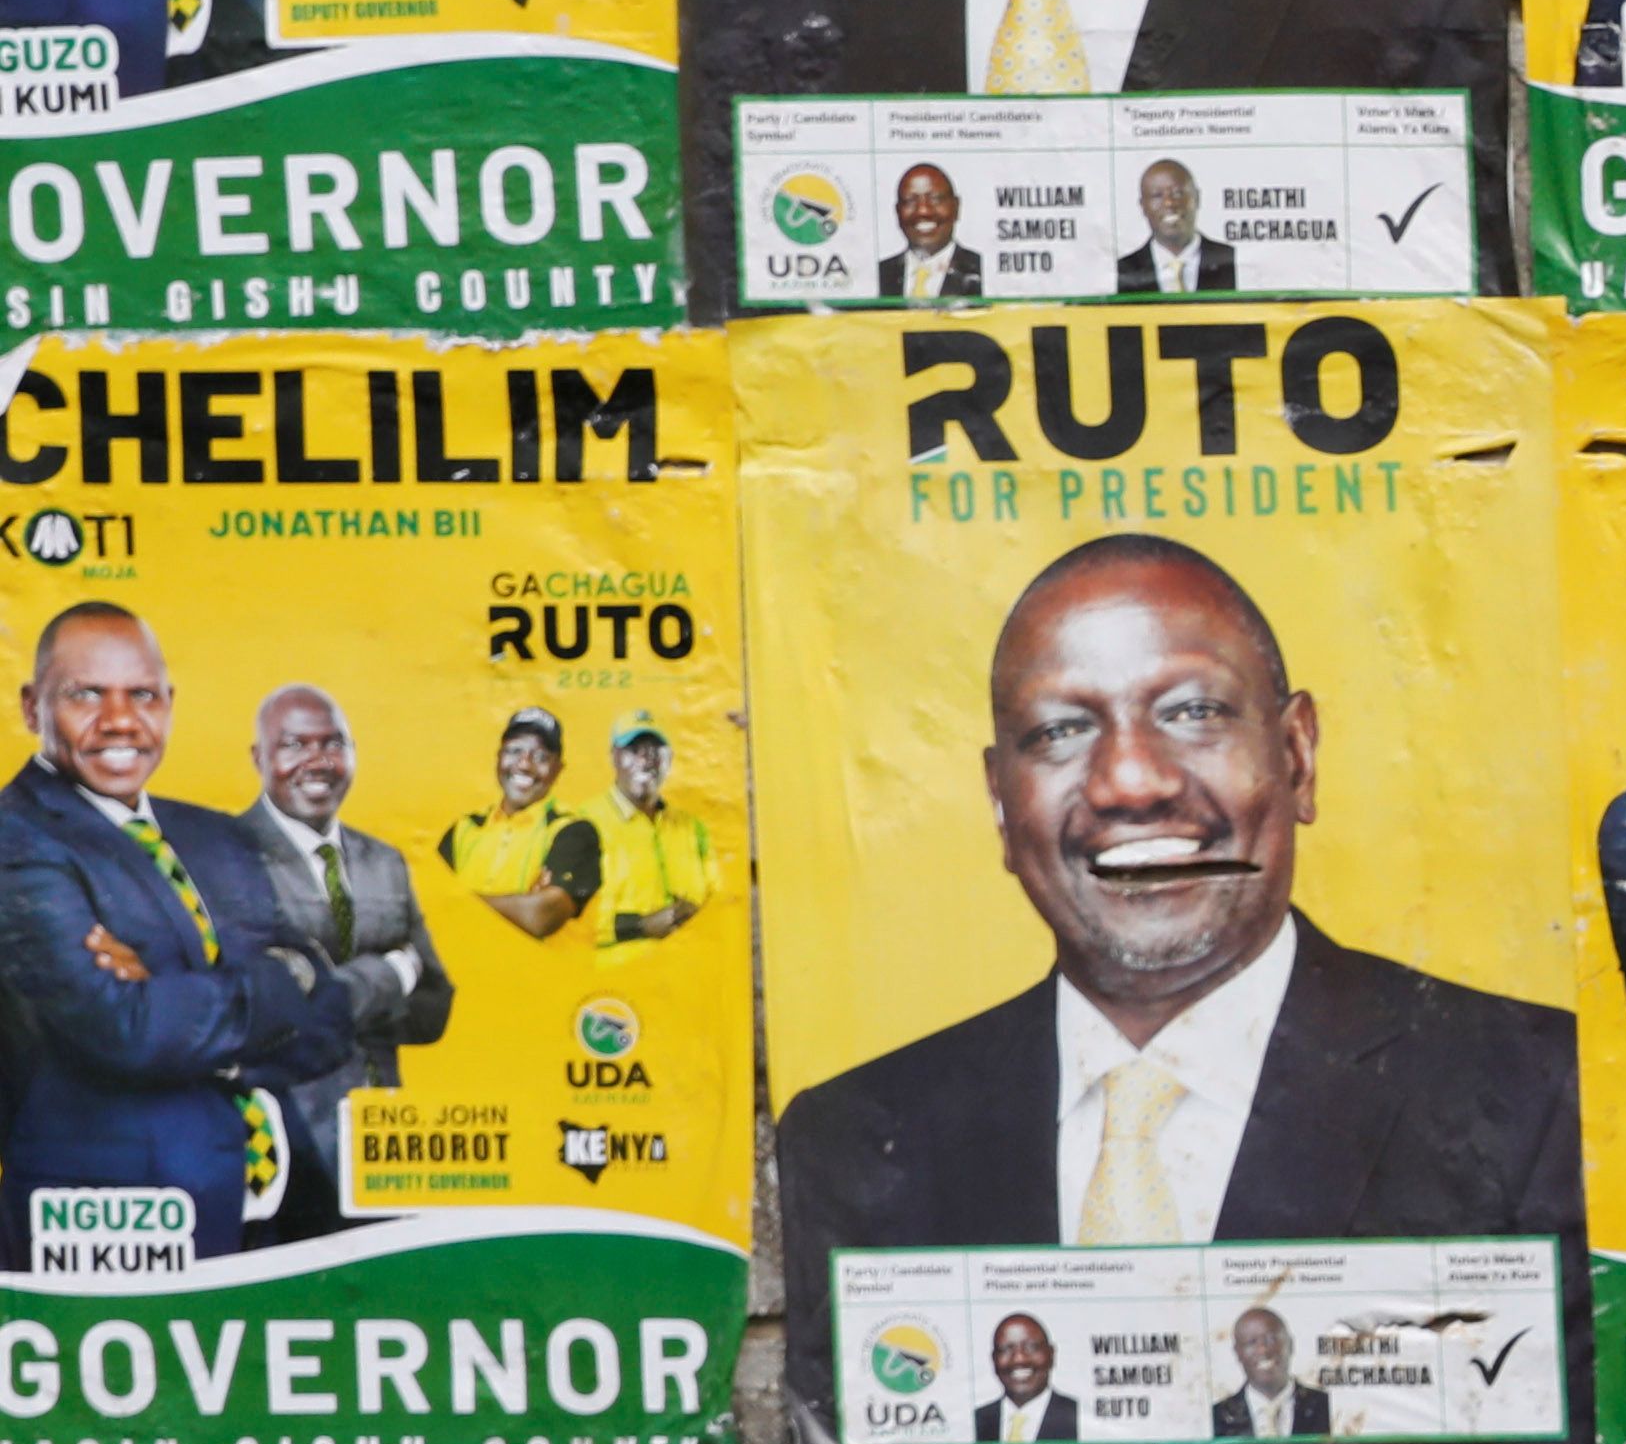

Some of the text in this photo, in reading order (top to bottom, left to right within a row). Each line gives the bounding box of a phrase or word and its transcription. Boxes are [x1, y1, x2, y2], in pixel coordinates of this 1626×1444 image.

[9, 144, 651, 262] OVERNOR
[995, 186, 1084, 207] WILLIAM
[1224, 189, 1306, 208] RIGATHI
[1226, 220, 1338, 240] GACHAGUA
[767, 255, 848, 277] UDA
[417, 265, 656, 312] COUNTY
[902, 315, 1401, 464] RUTO
[0, 368, 658, 485] CHELILIM
[911, 461, 1402, 523] FOR PRESIDENT
[209, 510, 482, 538] JONATHAN BII
[491, 572, 691, 599] GACHAGUA
[489, 605, 695, 662] RUTO
[566, 1061, 653, 1088] UDA
[363, 1132, 508, 1162] BAROROT
[41, 1198, 185, 1231] NGUZO
[91, 1243, 185, 1273] KUMI
[1090, 1333, 1180, 1355] WILLIAM
[0, 1318, 709, 1418] GOVERNOR
[866, 1404, 946, 1425] UDA
